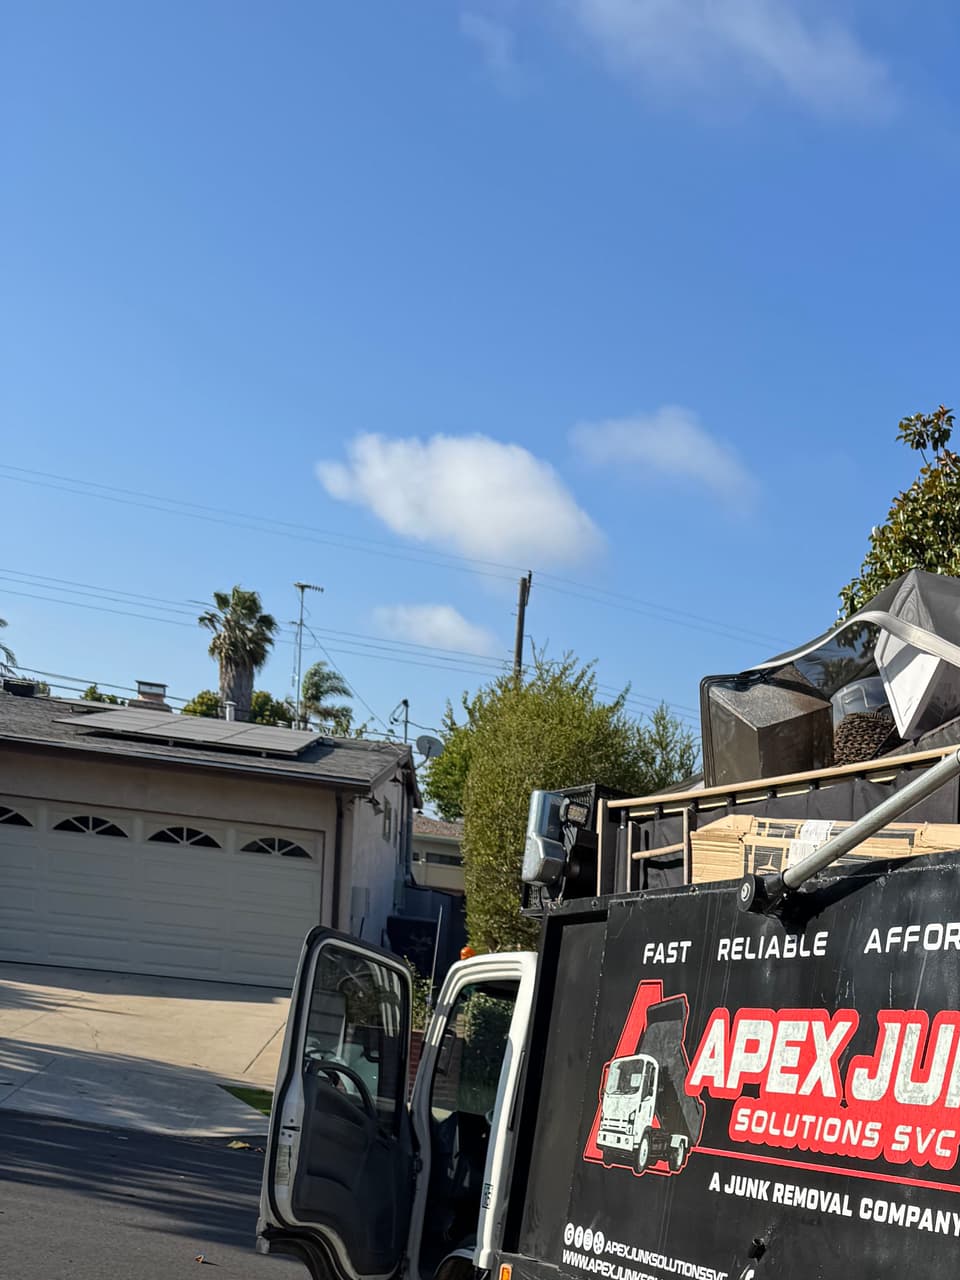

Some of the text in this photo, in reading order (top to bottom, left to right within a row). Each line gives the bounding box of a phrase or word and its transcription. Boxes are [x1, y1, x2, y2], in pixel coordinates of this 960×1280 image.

[643, 940, 692, 965] FAST
[717, 931, 829, 961] RELIABLE
[689, 1018, 854, 1098] APEX
[734, 1108, 956, 1159] SOLUTIONS SVC
[708, 1171, 722, 1193] A
[724, 1175, 770, 1202] JUNK
[772, 1182, 854, 1218] REMOVAL
